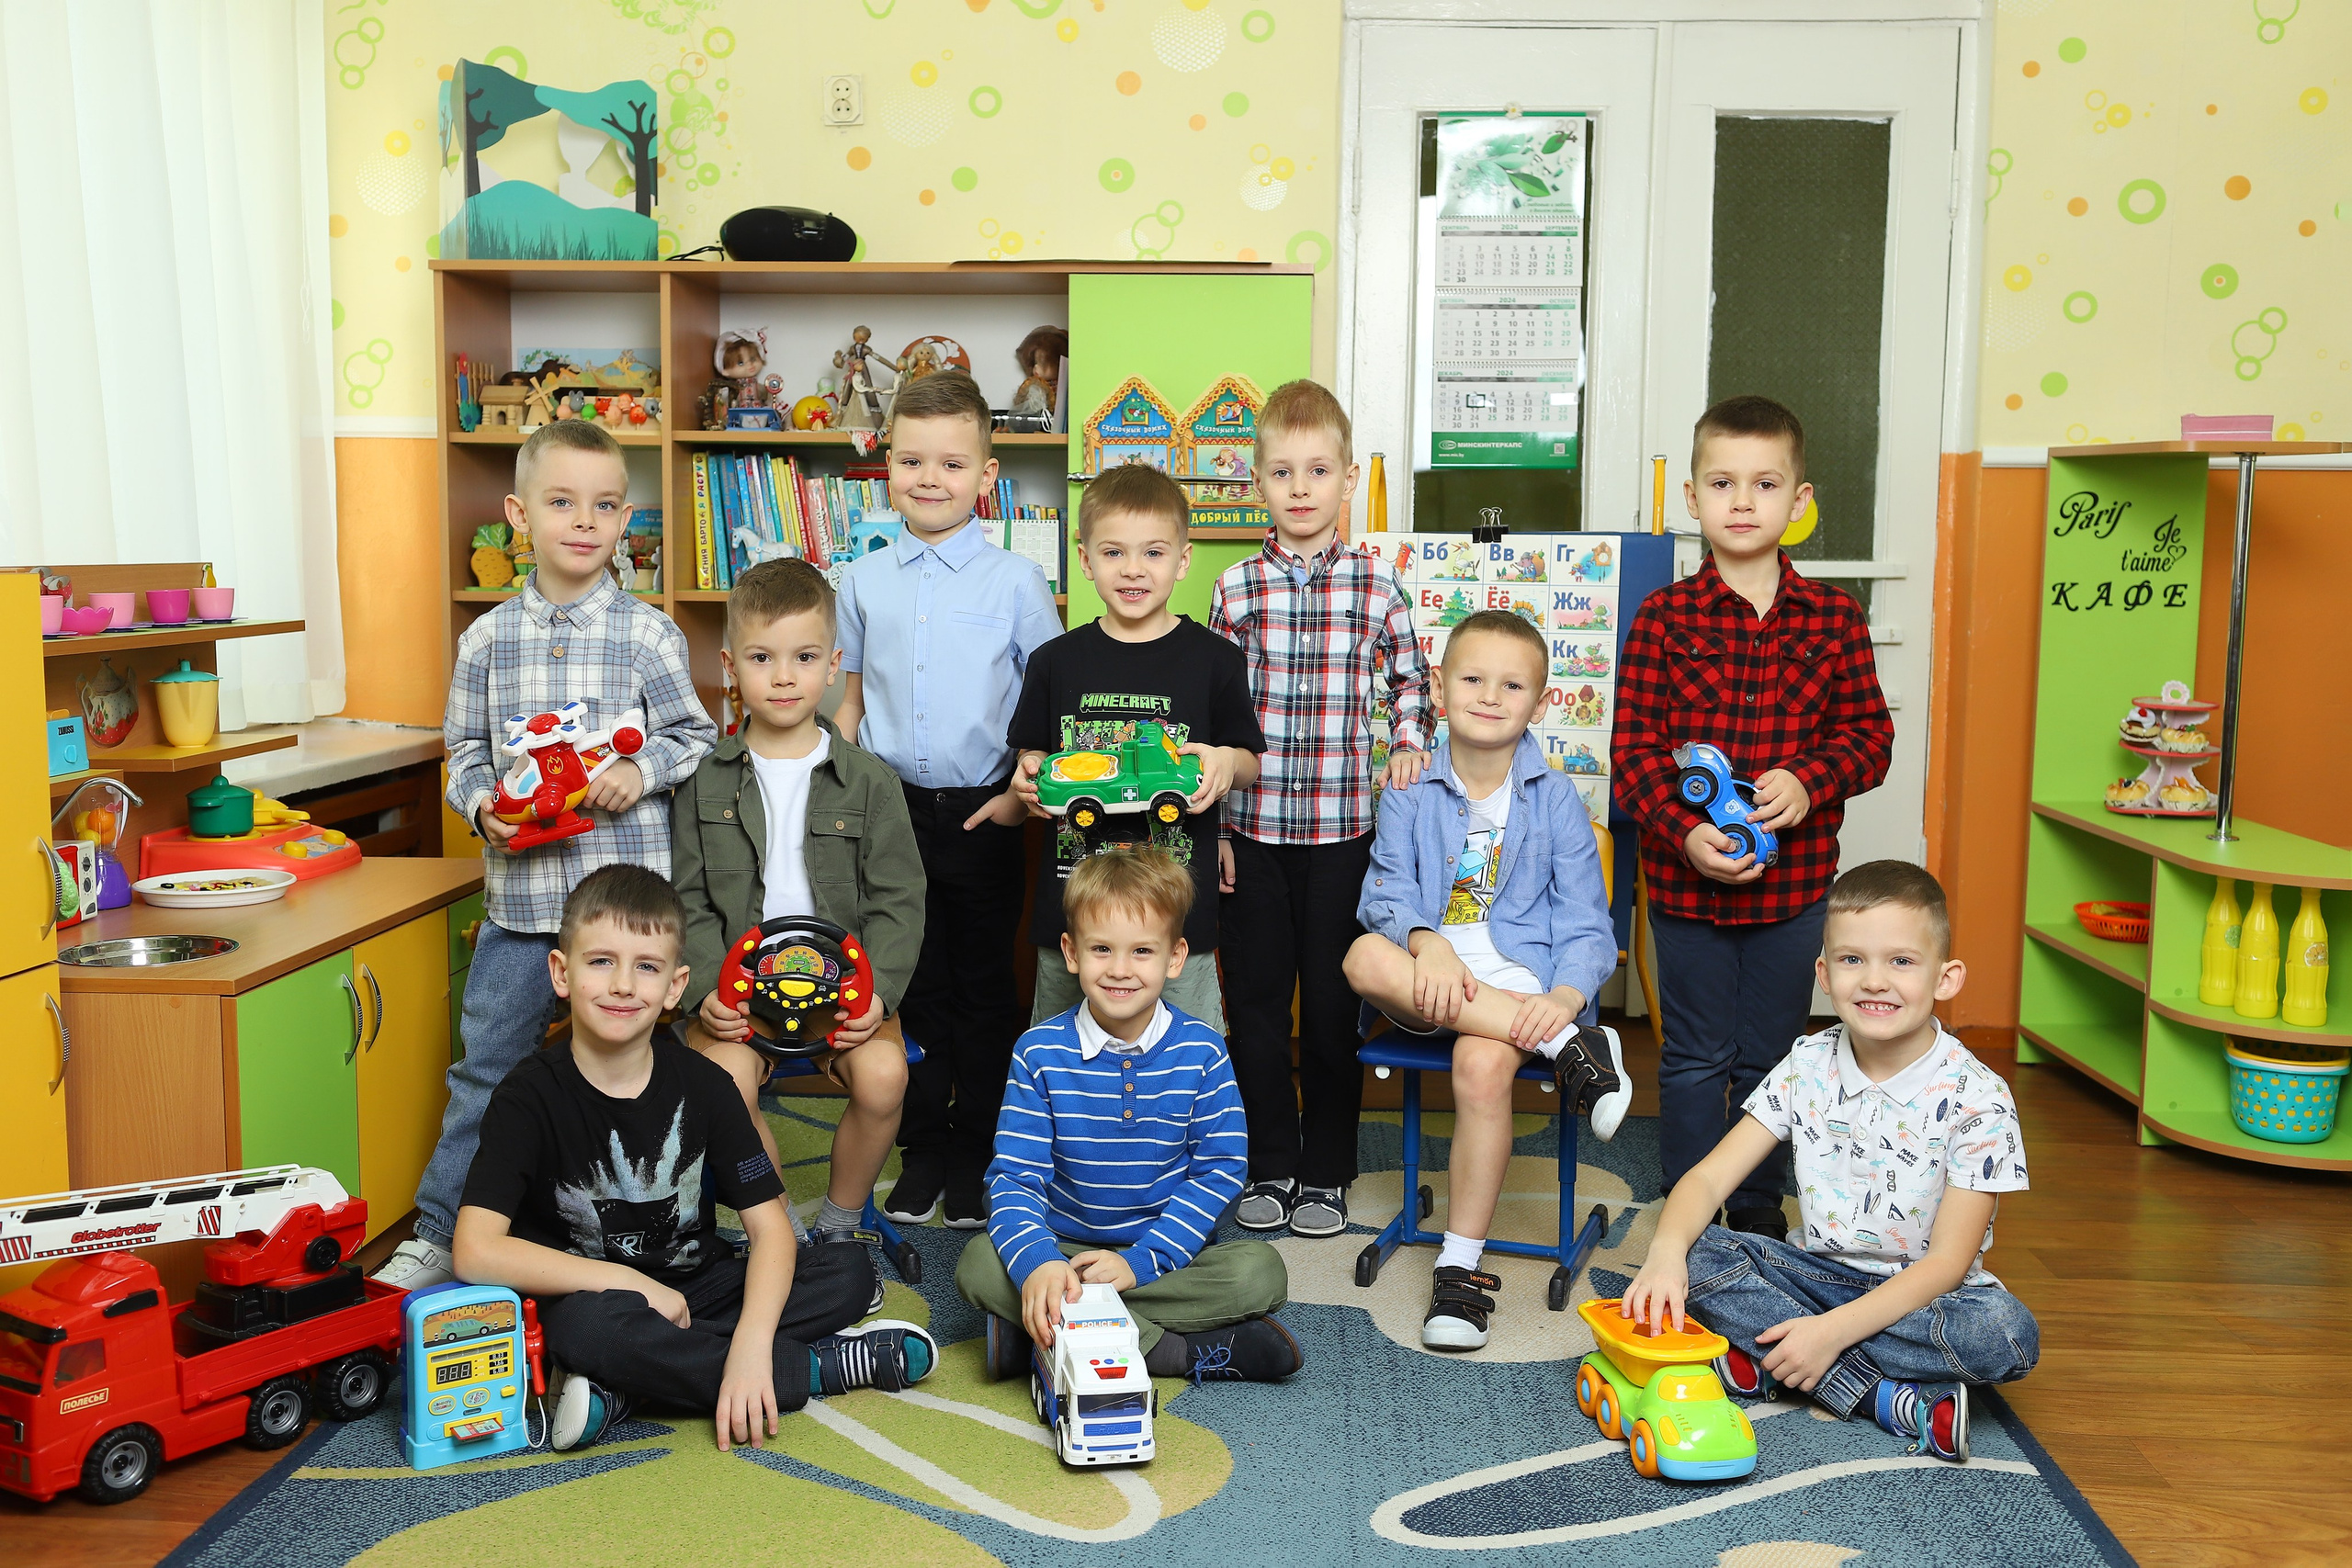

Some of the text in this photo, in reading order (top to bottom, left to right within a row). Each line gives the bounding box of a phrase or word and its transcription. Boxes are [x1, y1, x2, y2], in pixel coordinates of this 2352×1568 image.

[1101, 423, 1167, 434] СКАЗОЧНЫЙ ДОМИК
[1194, 423, 1254, 434] СКАЗОЧНЫЙ ДОМ
[696, 465, 705, 497] РАСТУ
[1191, 509, 1268, 525] ДОБРЫЙ ПЁС
[2053, 491, 2132, 539] Paris
[816, 508, 831, 561] СВЕТЛЯЧОК
[2154, 514, 2181, 553] Je
[1422, 541, 1449, 560] Бб
[1489, 544, 1514, 561] Вв
[1556, 544, 1575, 562] Гг
[2121, 549, 2174, 572] t'aime
[1420, 586, 1591, 611] Ее Ёё Жж
[1553, 639, 1578, 658] Кк
[1080, 694, 1172, 714] MINECRAFT
[1550, 687, 1577, 705] Оо
[1546, 736, 1567, 753] Тт
[1924, 1081, 1957, 1096] Surfing
[1804, 1130, 1815, 1145] WAVES
[1808, 1126, 1821, 1141] MAKE
[1901, 1148, 1919, 1162] MAKE
[1966, 1139, 1998, 1156] Surfing
[1896, 1154, 1915, 1168] WAVES
[70, 1221, 162, 1244] Globetrotter
[1885, 1227, 1908, 1250] Surfing
[1828, 1238, 1845, 1252] MAKE
[1081, 1319, 1114, 1328] POLICE
[63, 1392, 107, 1412] ПОЛЕСЬЕ
